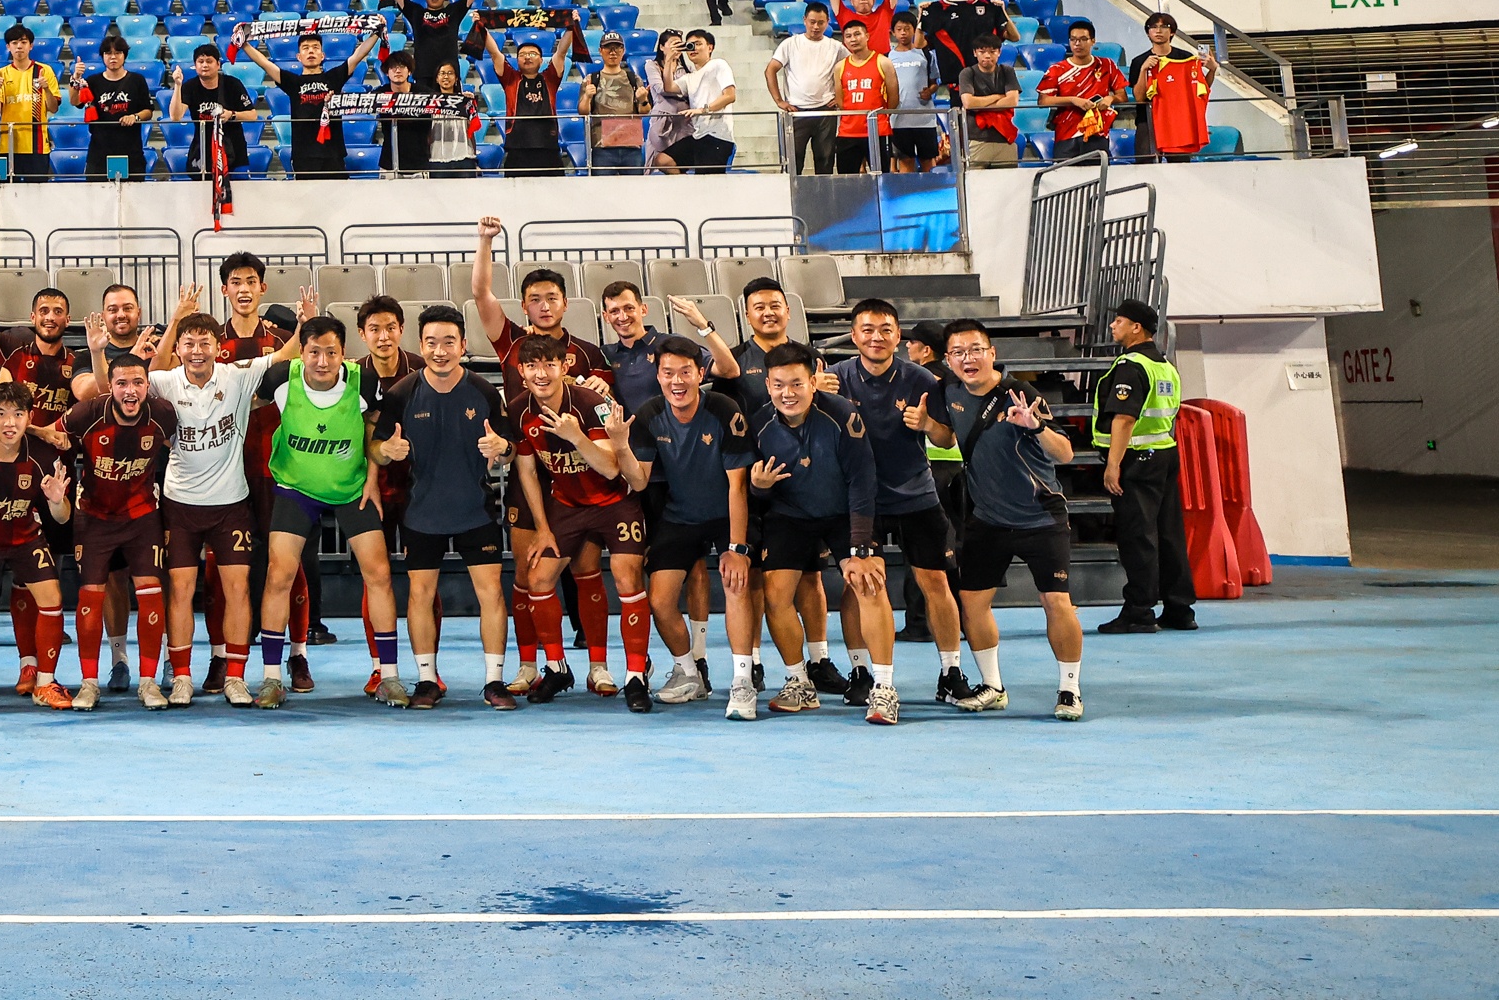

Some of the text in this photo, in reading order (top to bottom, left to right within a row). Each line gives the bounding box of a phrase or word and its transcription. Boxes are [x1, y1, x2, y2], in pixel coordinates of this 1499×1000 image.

[851, 92, 864, 104] 10
[1343, 347, 1395, 384] GATE 2
[45, 401, 69, 412] AURA
[178, 412, 236, 444] 速力奥
[179, 431, 238, 452] SULI AURA
[94, 455, 151, 474] 速力奥
[93, 469, 119, 481] SULI
[617, 521, 642, 543] 36
